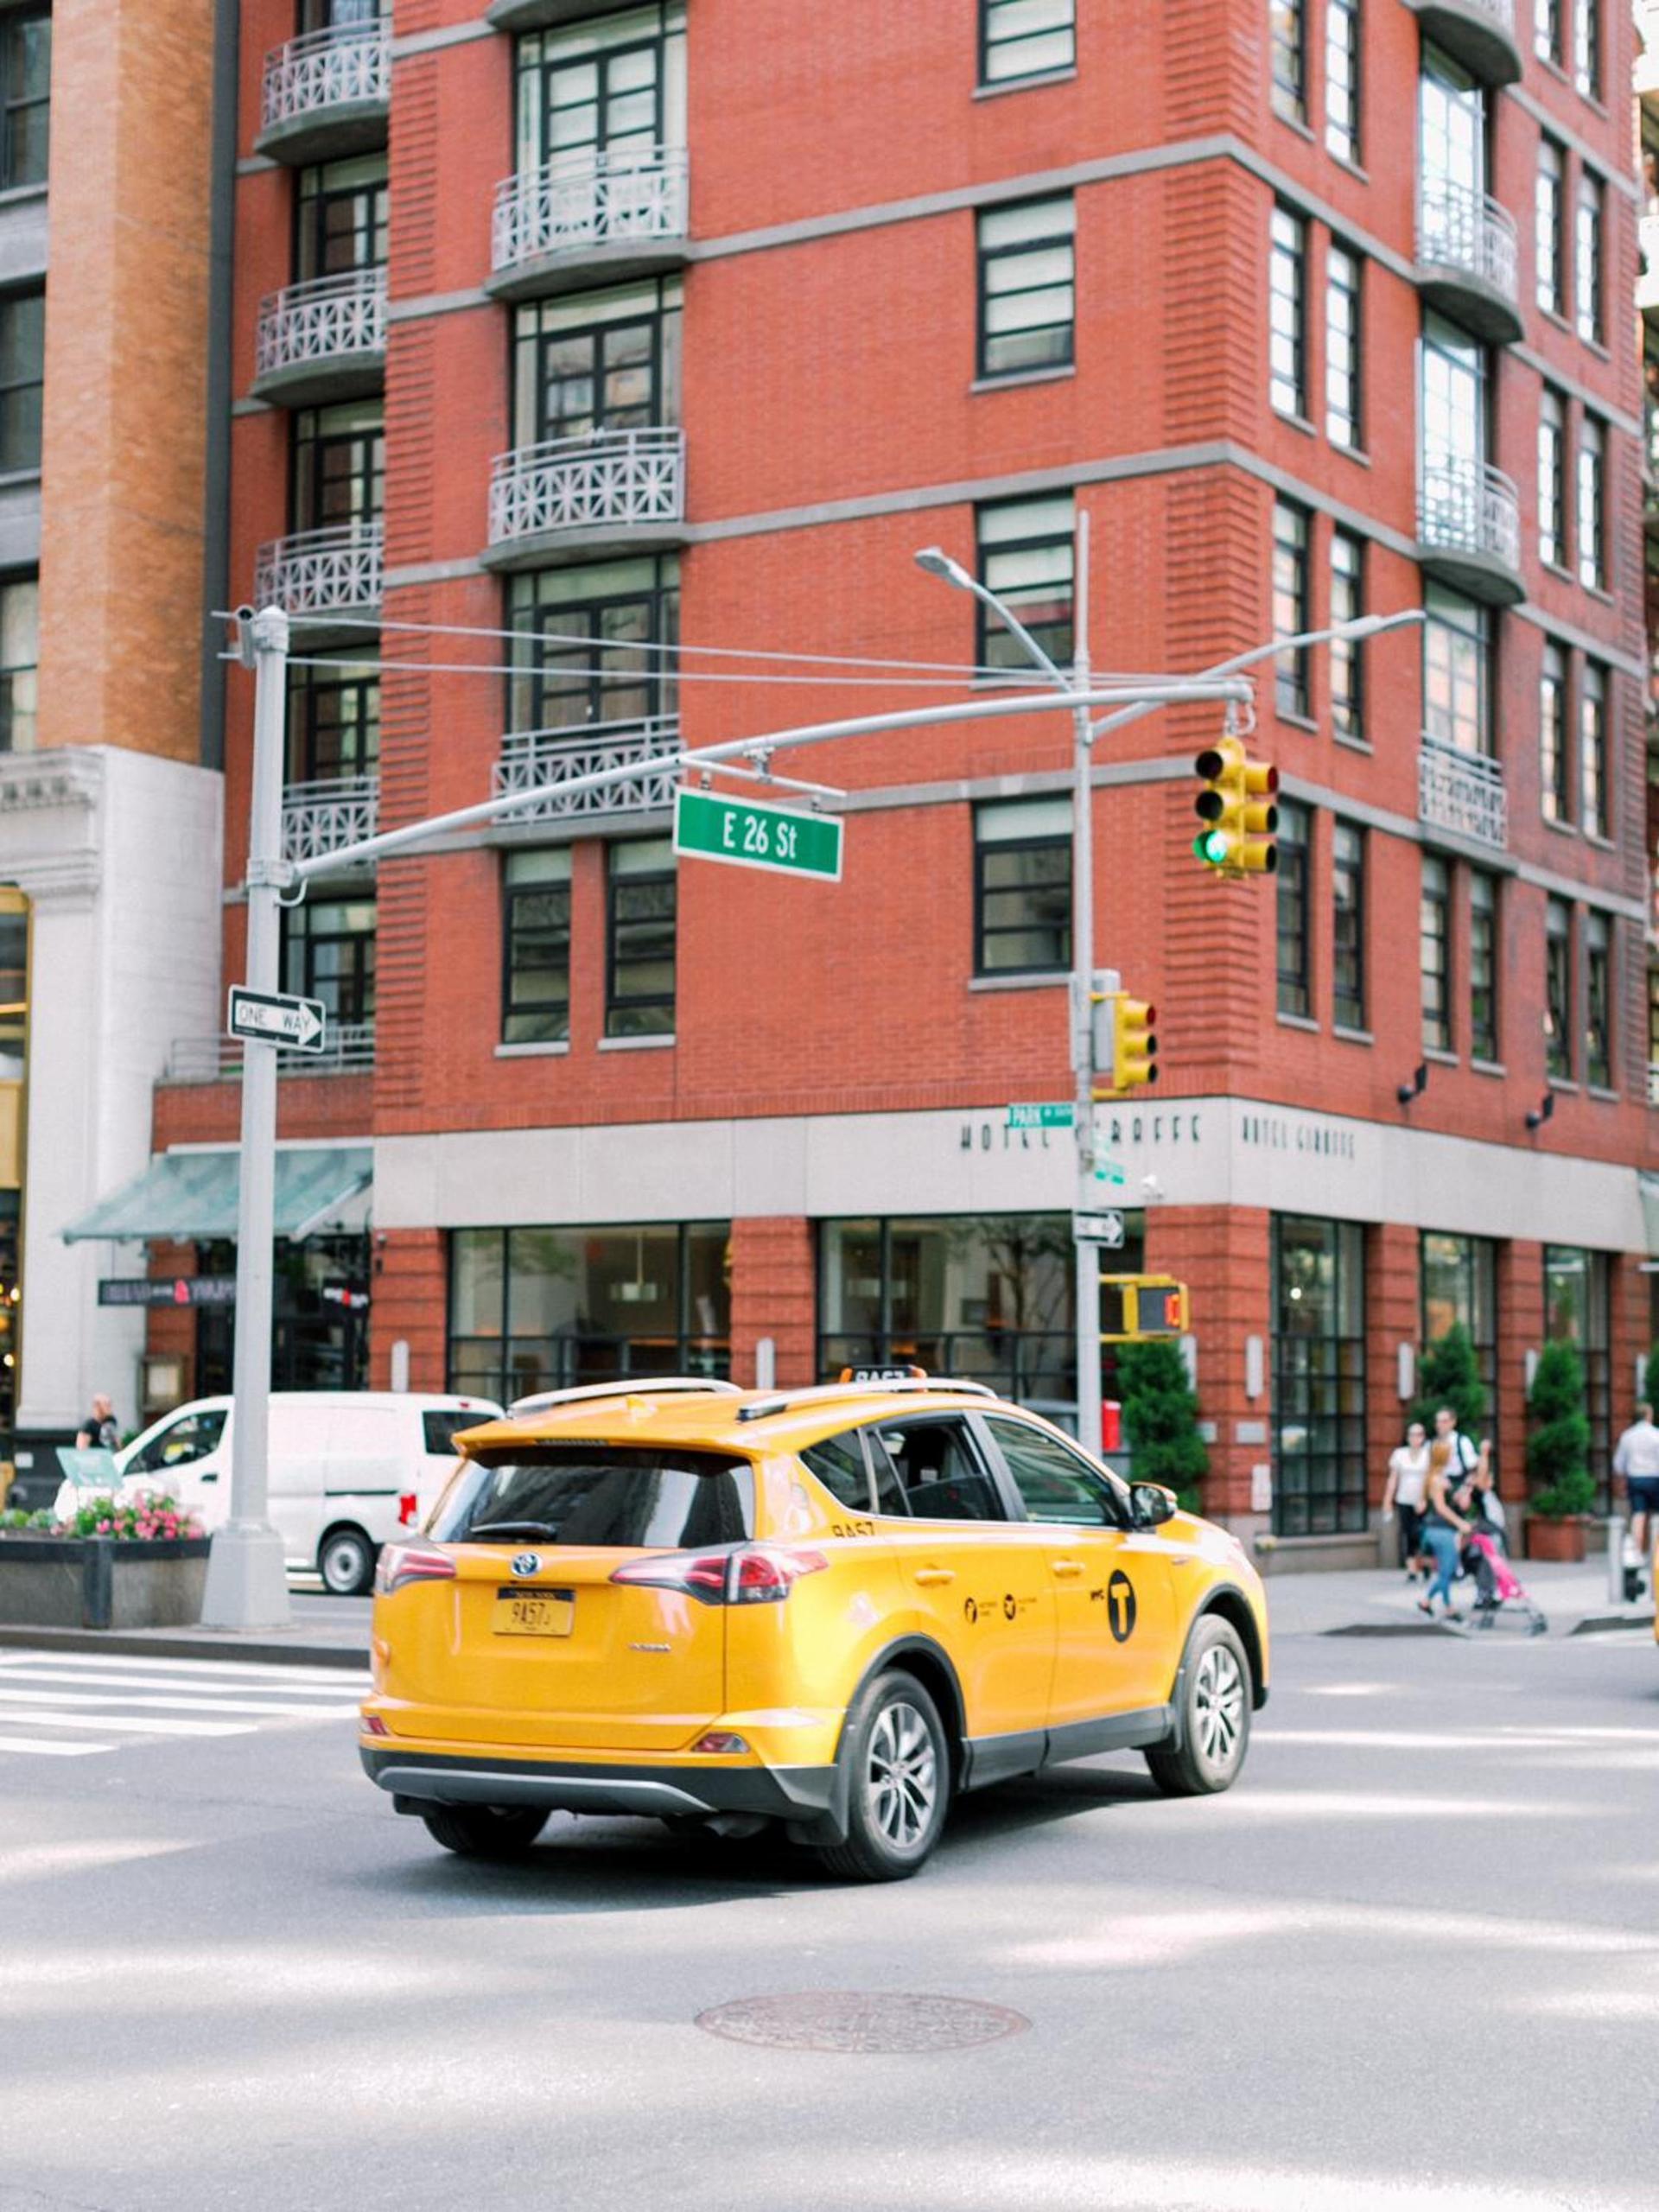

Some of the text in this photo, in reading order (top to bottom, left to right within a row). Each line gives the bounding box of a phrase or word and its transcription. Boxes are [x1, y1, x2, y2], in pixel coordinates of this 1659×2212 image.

[723, 810, 798, 859] E 26 St
[239, 1004, 311, 1034] ONE WAY
[1013, 1106, 1040, 1125] PARK
[831, 1521, 874, 1537] 9A57
